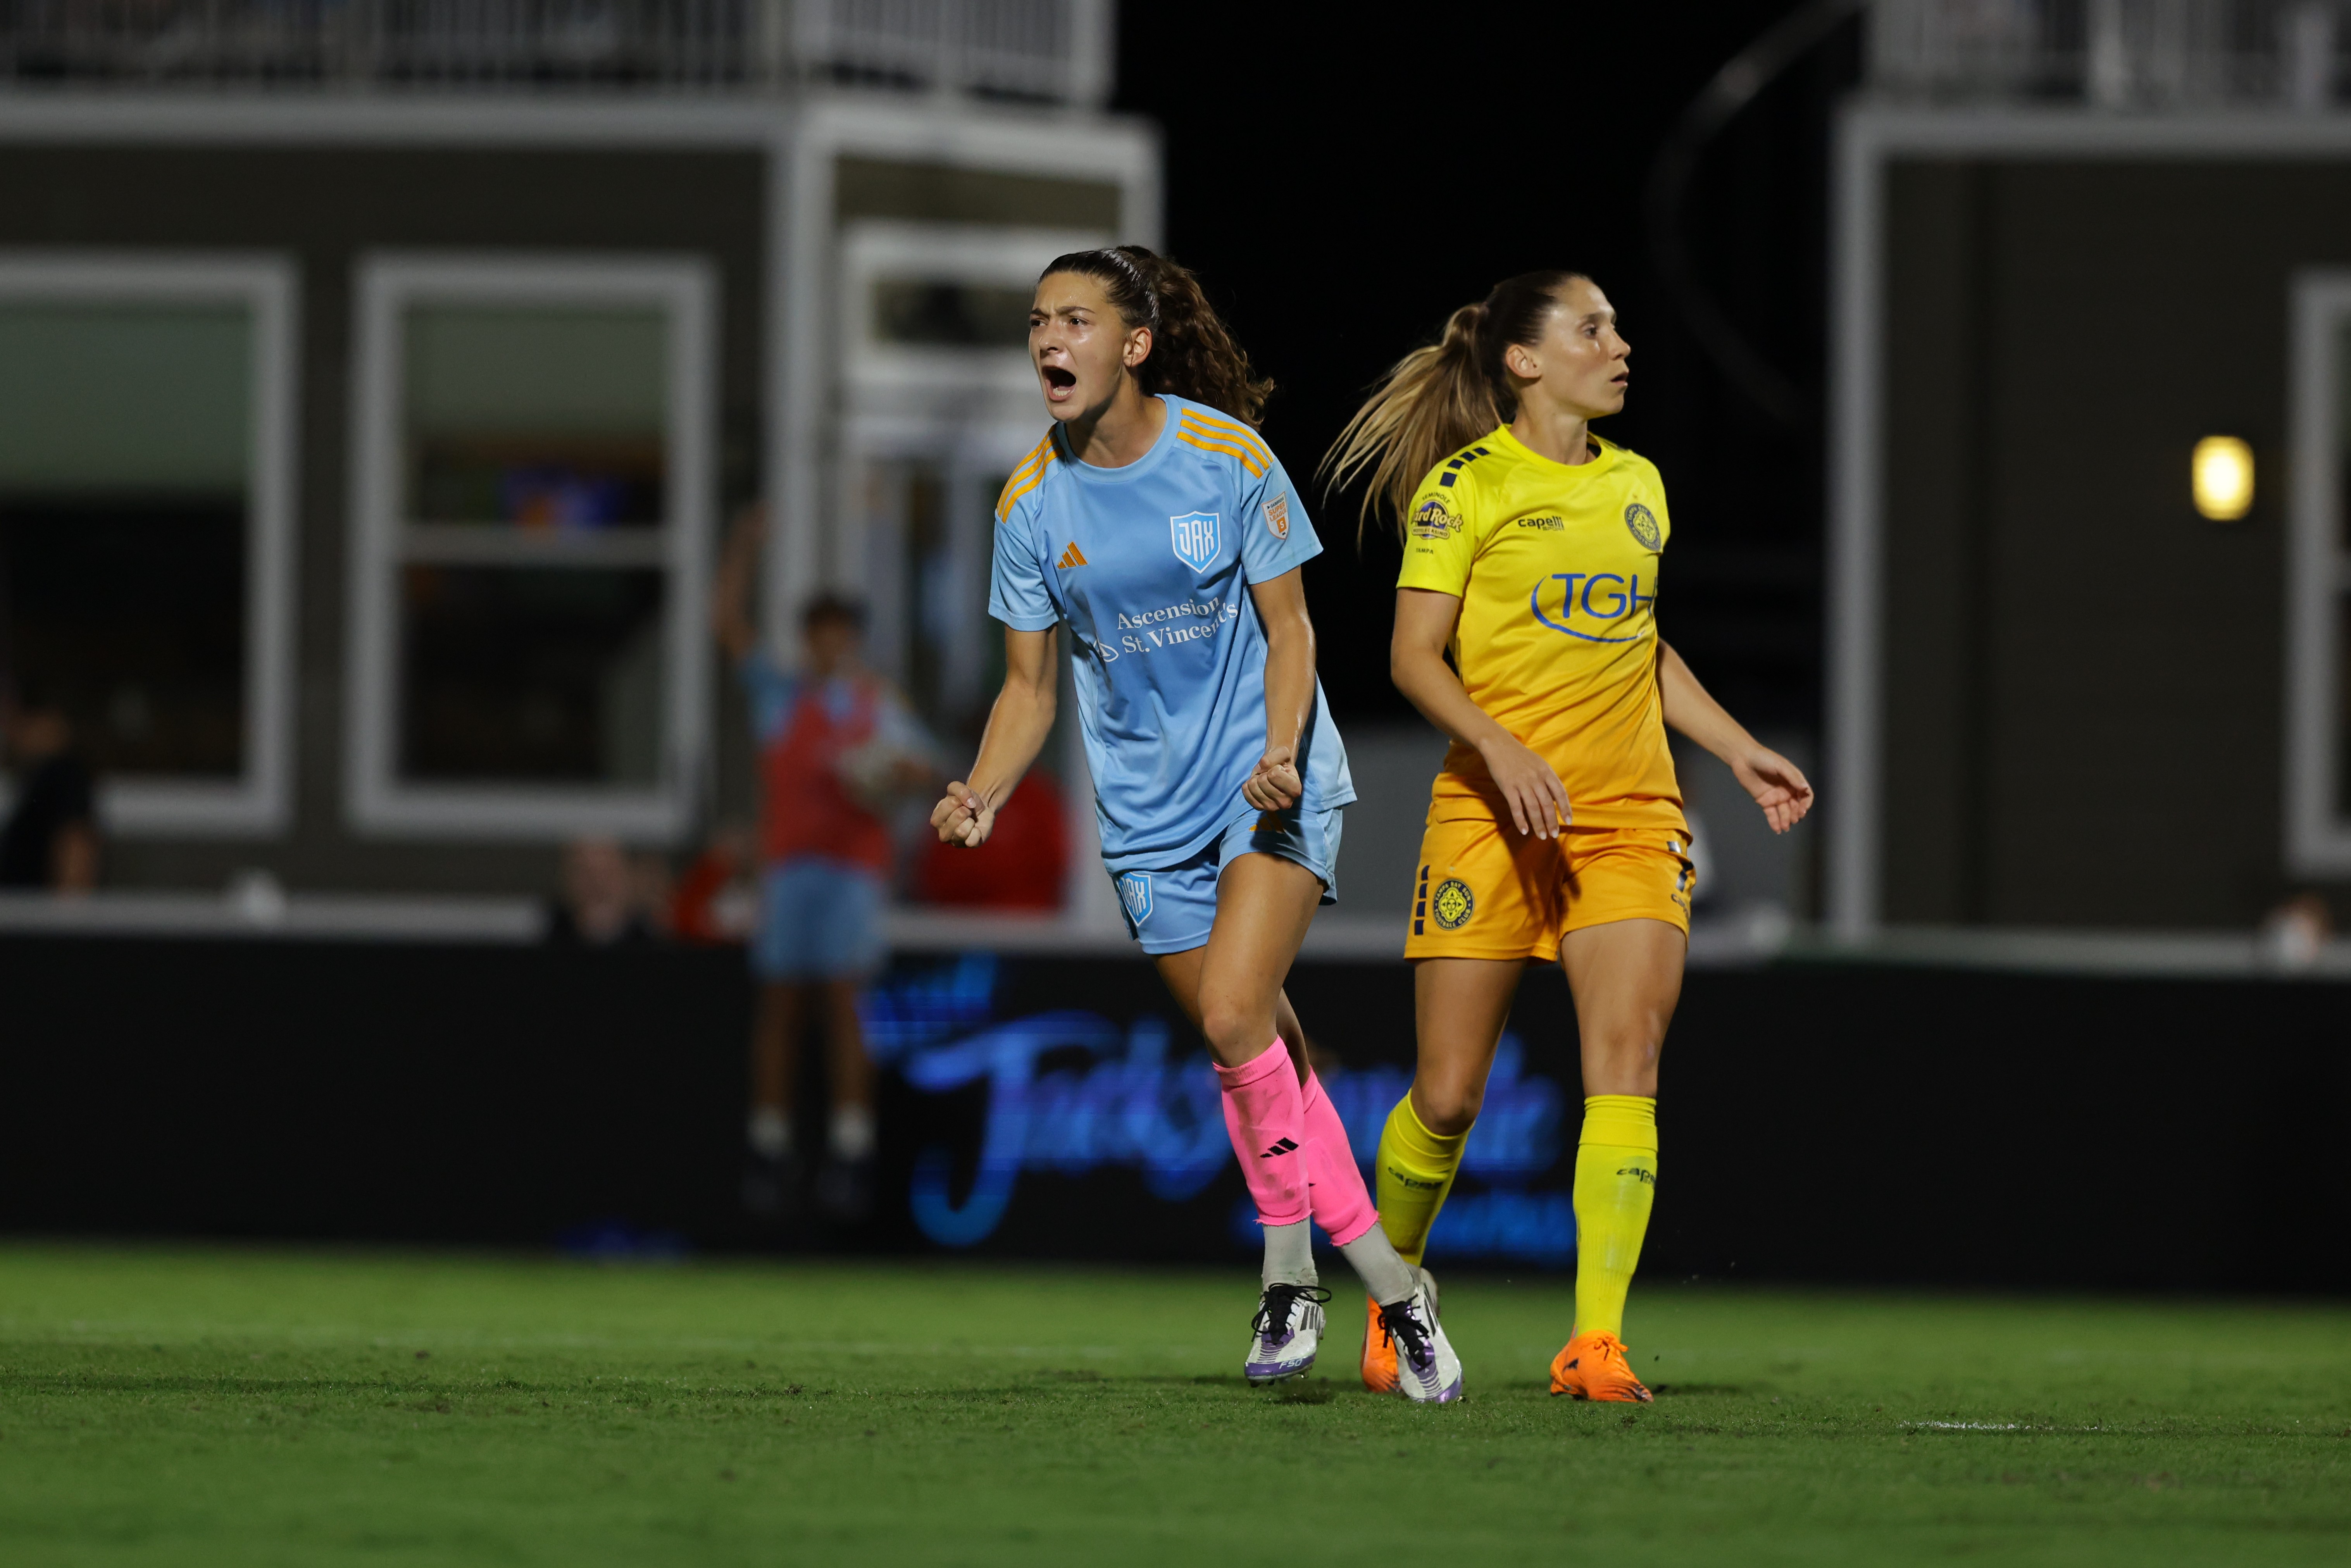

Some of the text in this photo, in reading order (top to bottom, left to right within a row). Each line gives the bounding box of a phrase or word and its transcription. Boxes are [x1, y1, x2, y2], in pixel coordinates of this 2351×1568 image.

[1268, 501, 1286, 516] SUPER
[1422, 492, 1450, 504] SEMINOLE
[1429, 507, 1463, 532] Rock
[1179, 520, 1214, 562] JAX
[1552, 573, 1658, 619] TGH
[1117, 597, 1220, 630] Ascension
[1122, 602, 1238, 653] St. Vincent's
[1120, 877, 1146, 917] JAX
[1279, 1358, 1302, 1369] F50
